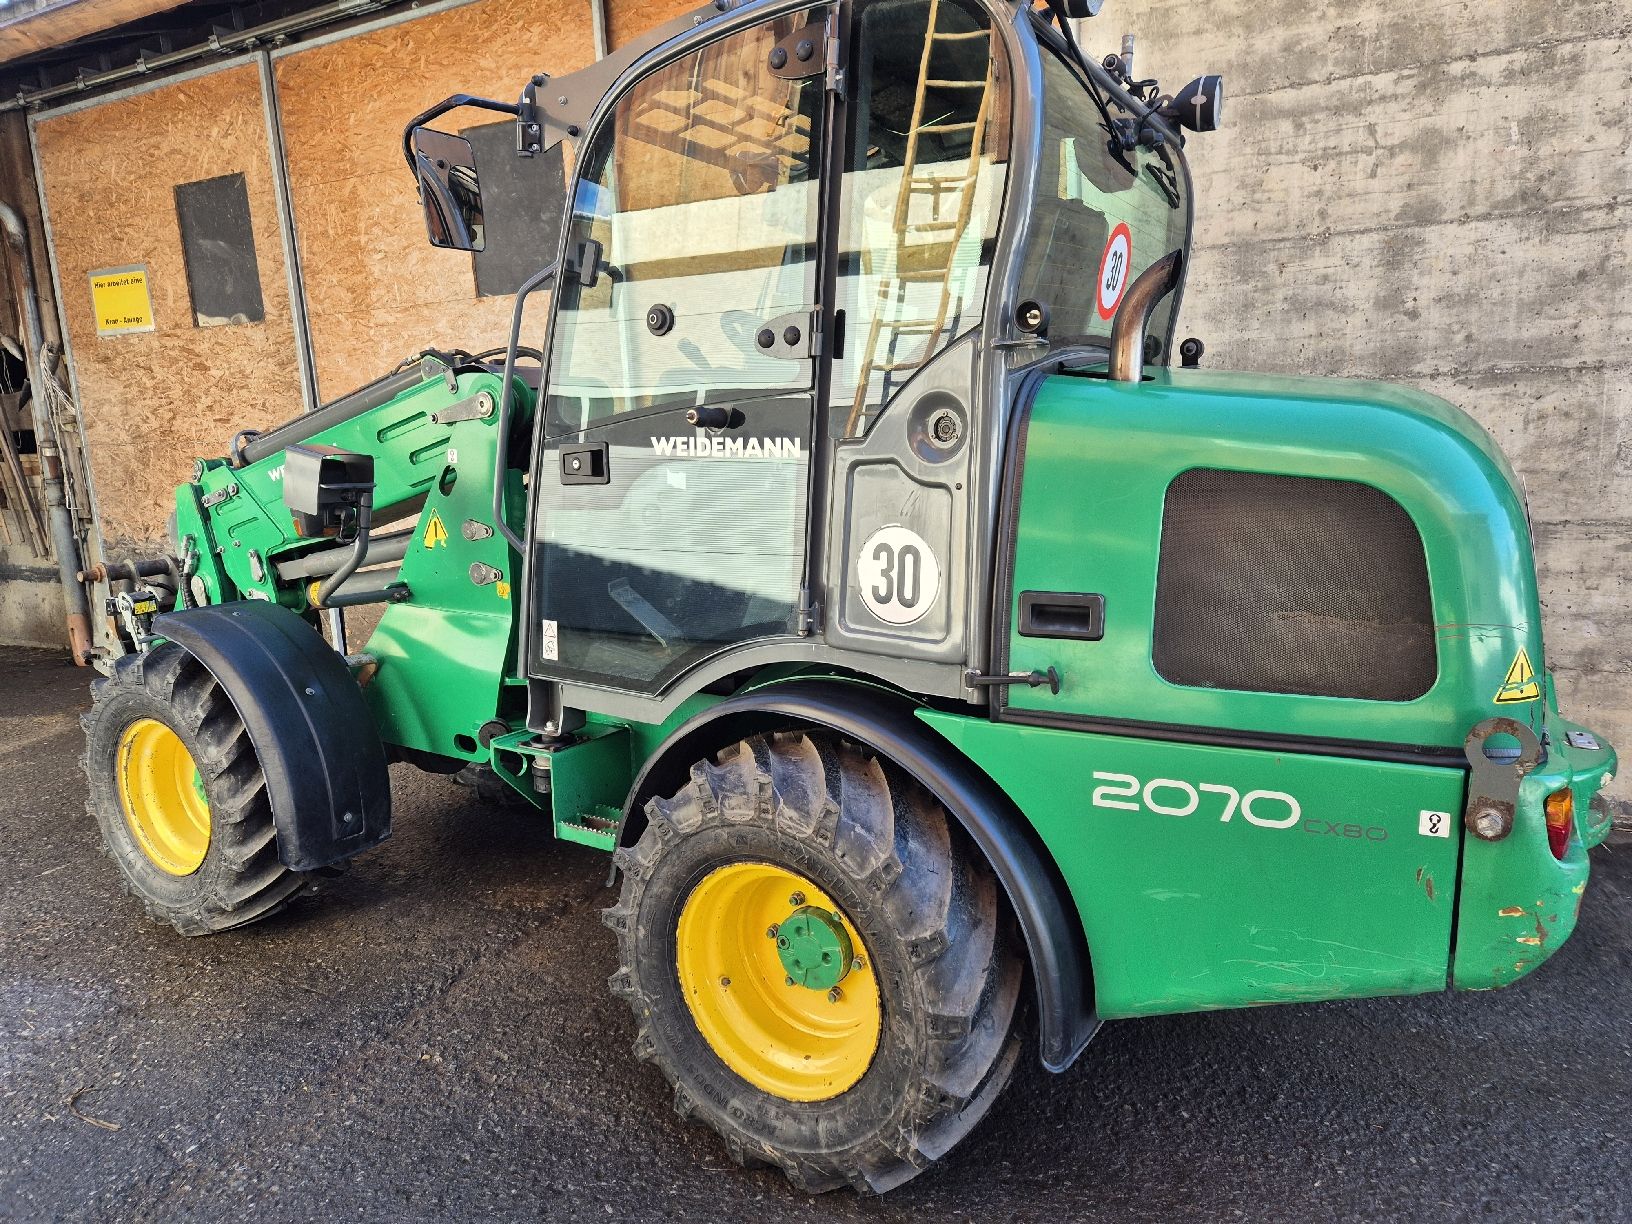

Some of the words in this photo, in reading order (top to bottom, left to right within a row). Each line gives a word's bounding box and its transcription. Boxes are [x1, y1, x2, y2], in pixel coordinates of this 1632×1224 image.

[1106, 250, 1123, 291] 30
[650, 436, 801, 458] WEIDEMANN
[871, 542, 922, 608] 30
[1092, 771, 1301, 829] 2070
[1303, 819, 1388, 842] CX80
